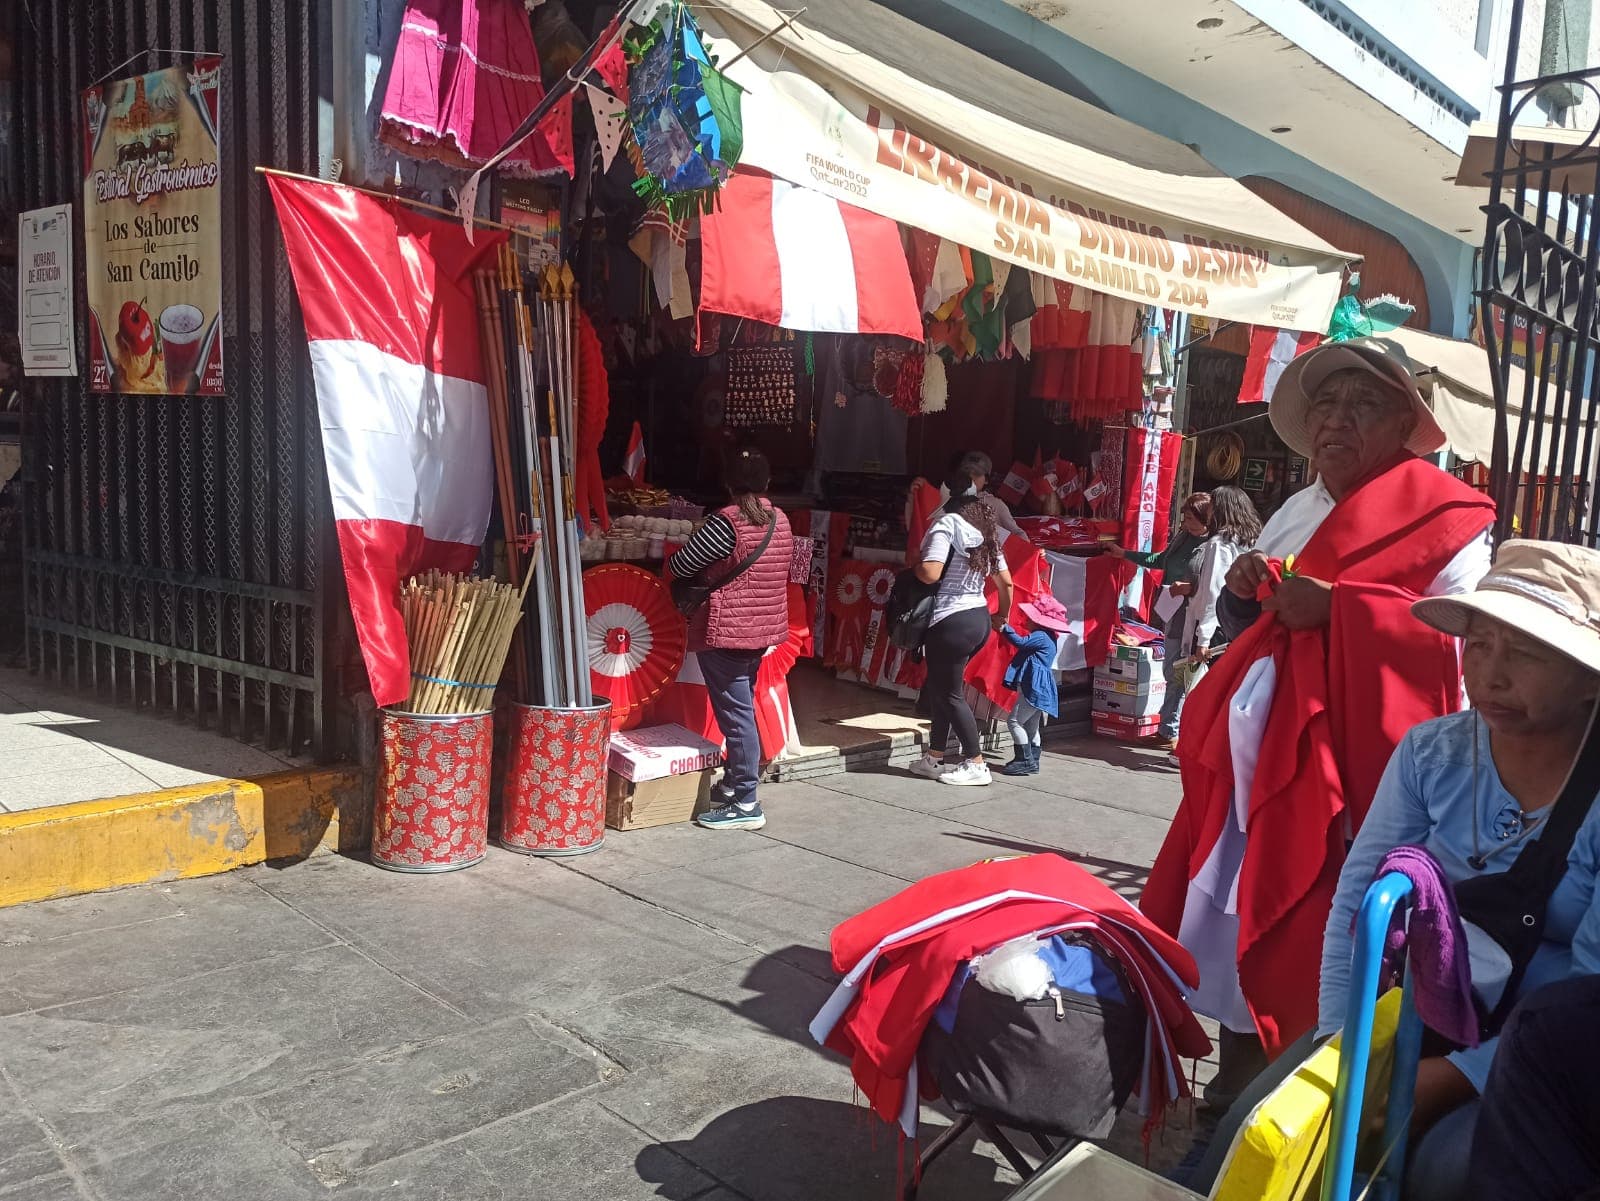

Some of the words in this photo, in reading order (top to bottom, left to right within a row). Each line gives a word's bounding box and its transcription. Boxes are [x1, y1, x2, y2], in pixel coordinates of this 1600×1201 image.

[95, 163, 132, 204] Festival
[134, 158, 218, 204] Gastronómico
[806, 152, 824, 168] FIFA
[825, 160, 855, 180] WORLD
[855, 173, 870, 185] CUP
[106, 220, 129, 242] Los
[134, 212, 200, 240] Sabores
[33, 251, 57, 267] HORARIO
[143, 238, 157, 254] de
[28, 269, 36, 283] DE
[107, 261, 133, 283] San
[139, 254, 200, 282] Camilo
[994, 221, 1056, 269] SAN
[1065, 249, 1161, 299] CAMILO
[1167, 279, 1209, 309] 204
[93, 365, 106, 382] 27
